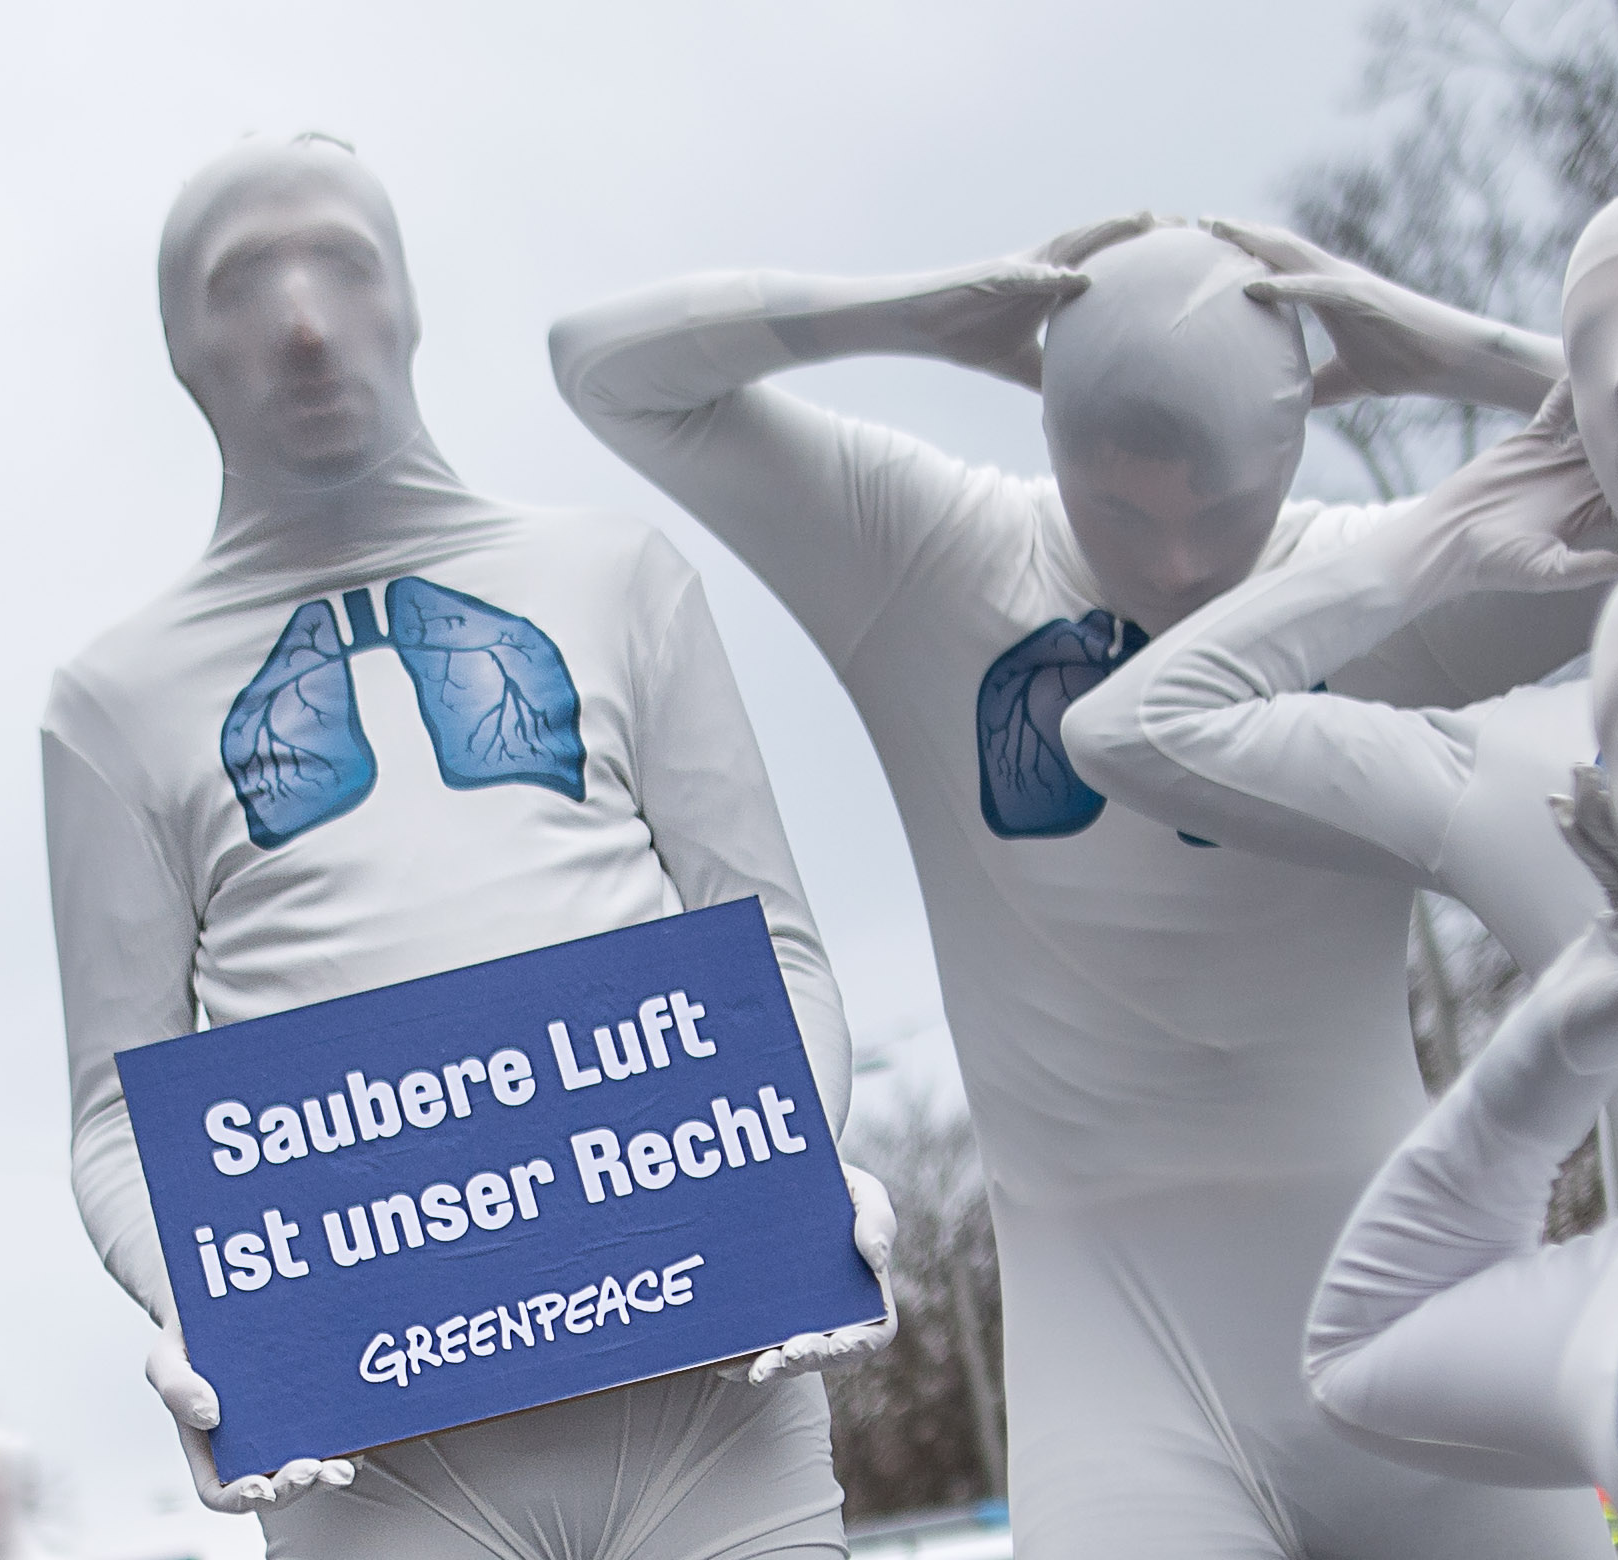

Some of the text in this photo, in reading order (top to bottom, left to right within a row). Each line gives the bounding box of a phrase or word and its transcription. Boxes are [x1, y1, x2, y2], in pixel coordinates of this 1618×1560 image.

[205, 991, 717, 1176] Saubere Luft
[194, 1085, 807, 1298] ist unser Recht
[359, 1254, 705, 1387] GREENPEACE
